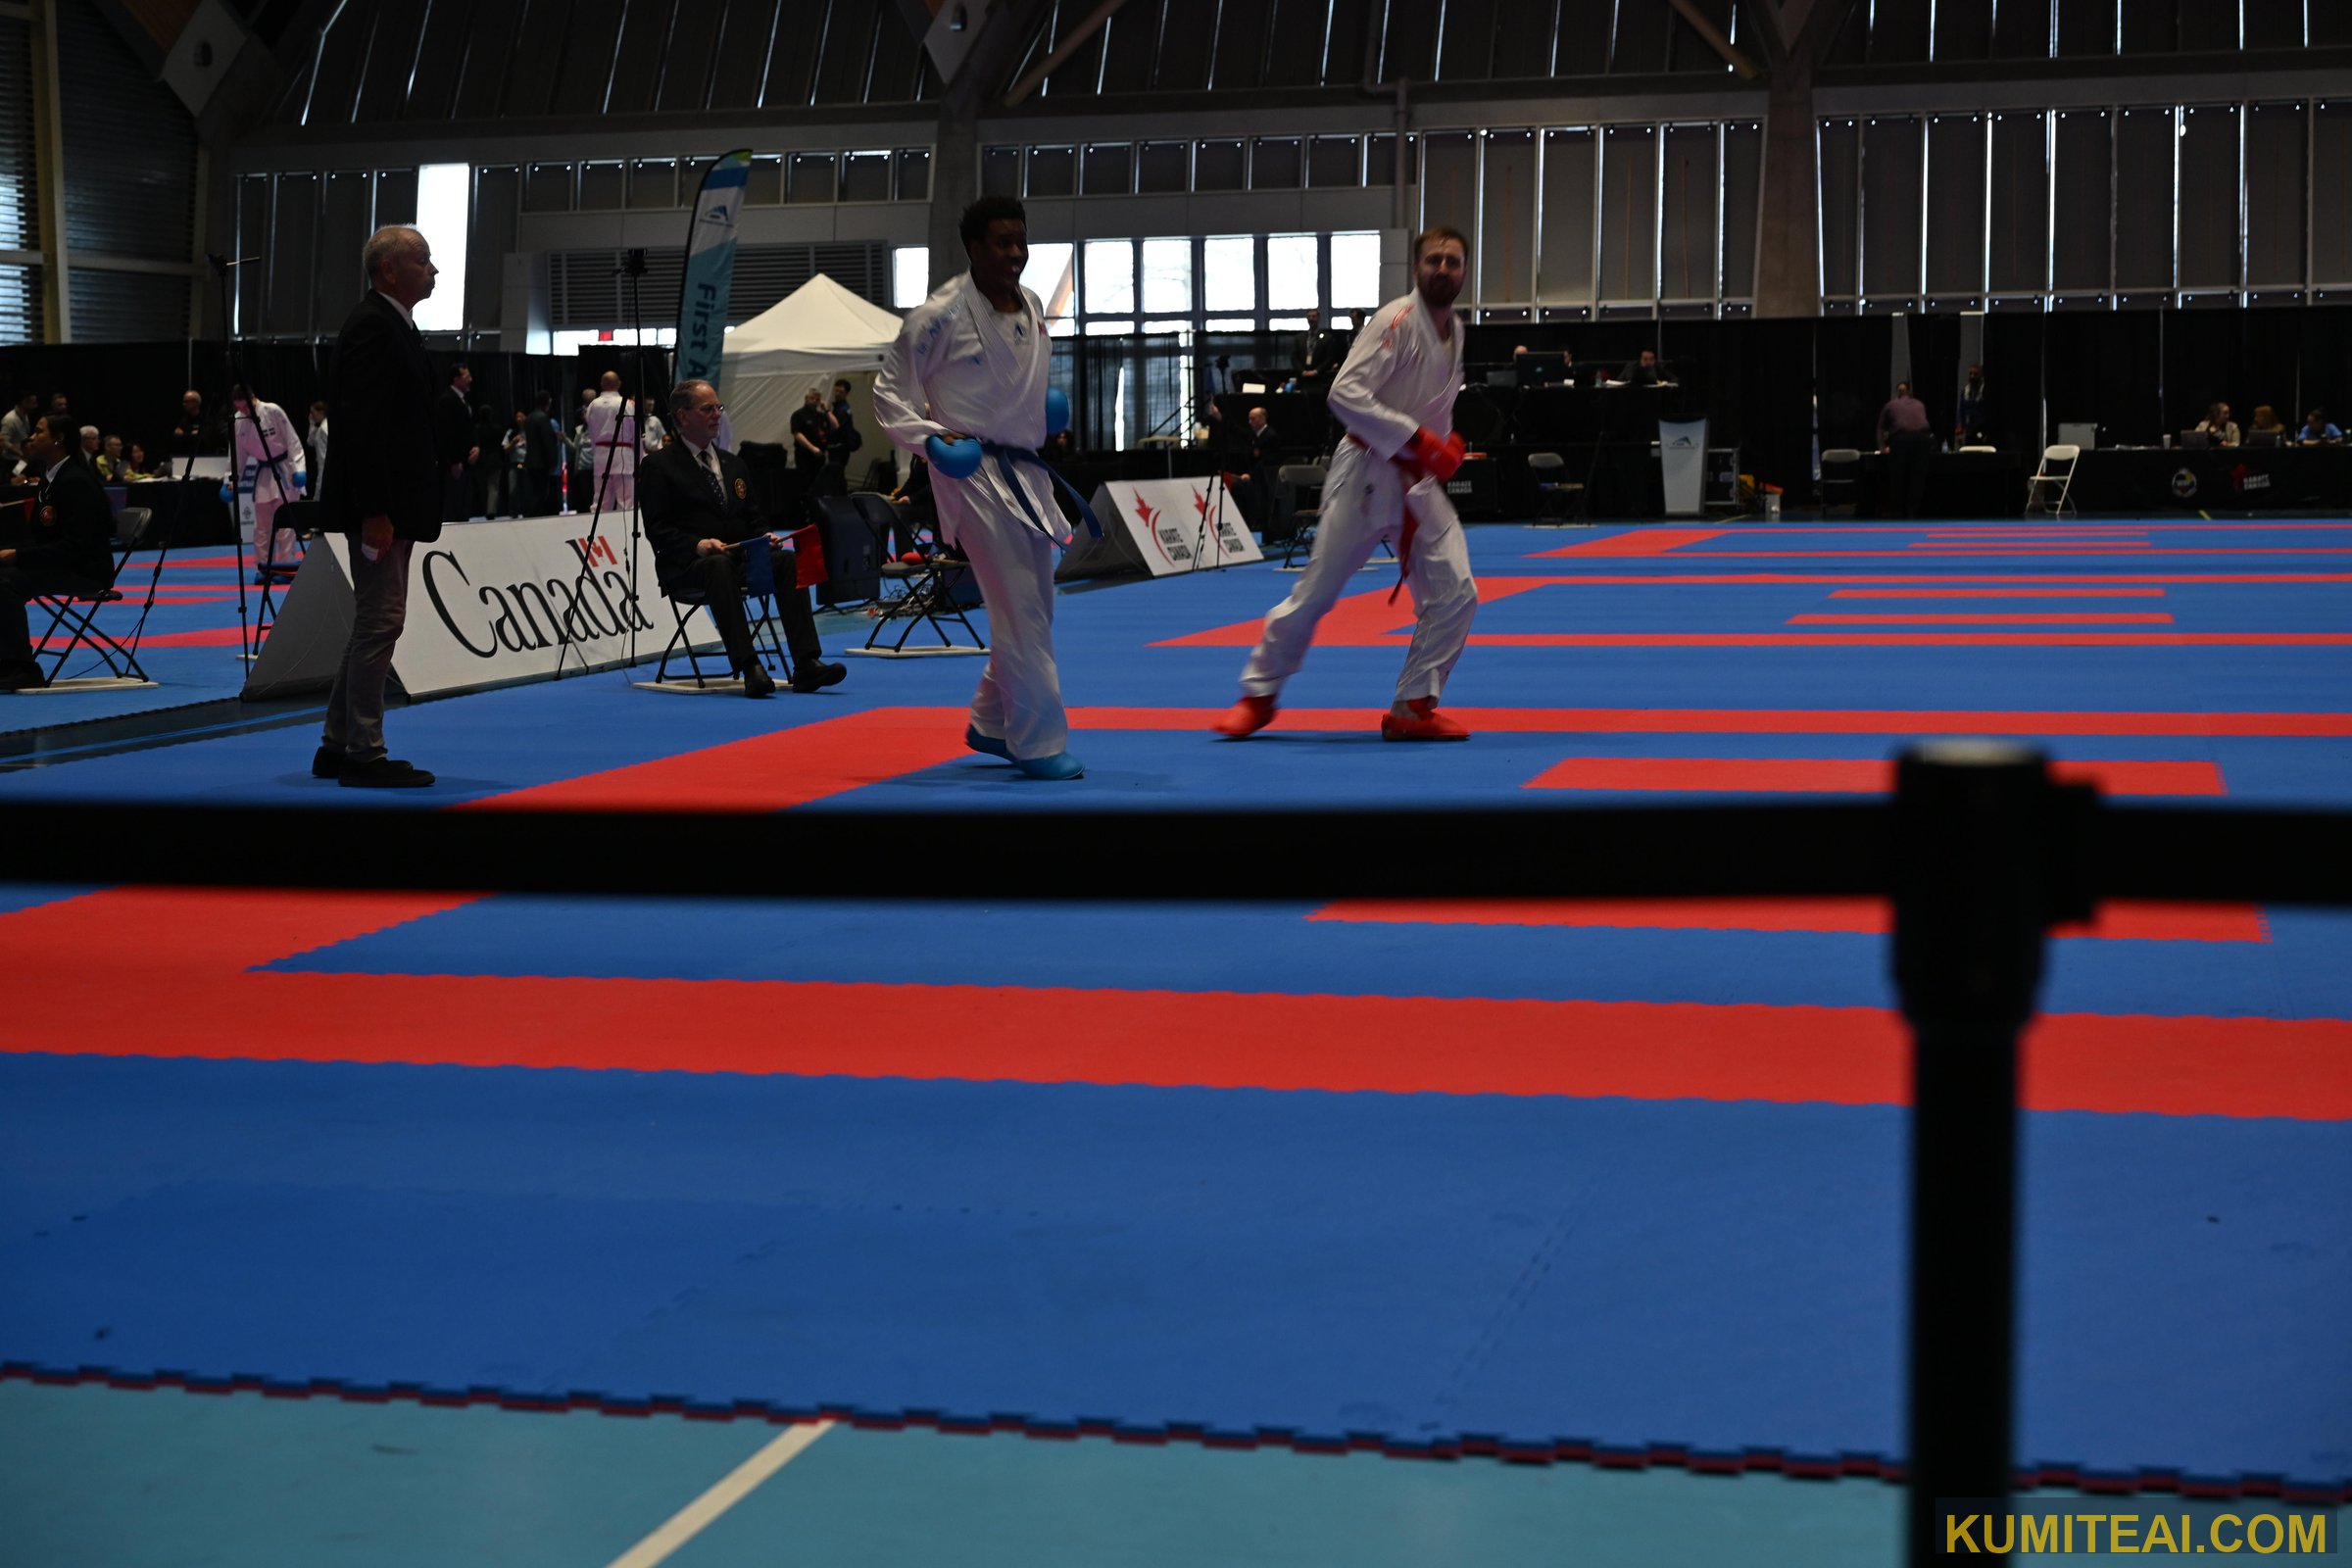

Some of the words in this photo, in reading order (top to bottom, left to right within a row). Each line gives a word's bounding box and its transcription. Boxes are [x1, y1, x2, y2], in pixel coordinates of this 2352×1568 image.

[690, 282, 715, 351] First
[1158, 527, 1183, 544] KARATE
[1167, 545, 1192, 561] CANADA
[1223, 538, 1245, 554] CANADA
[422, 539, 654, 658] Canada
